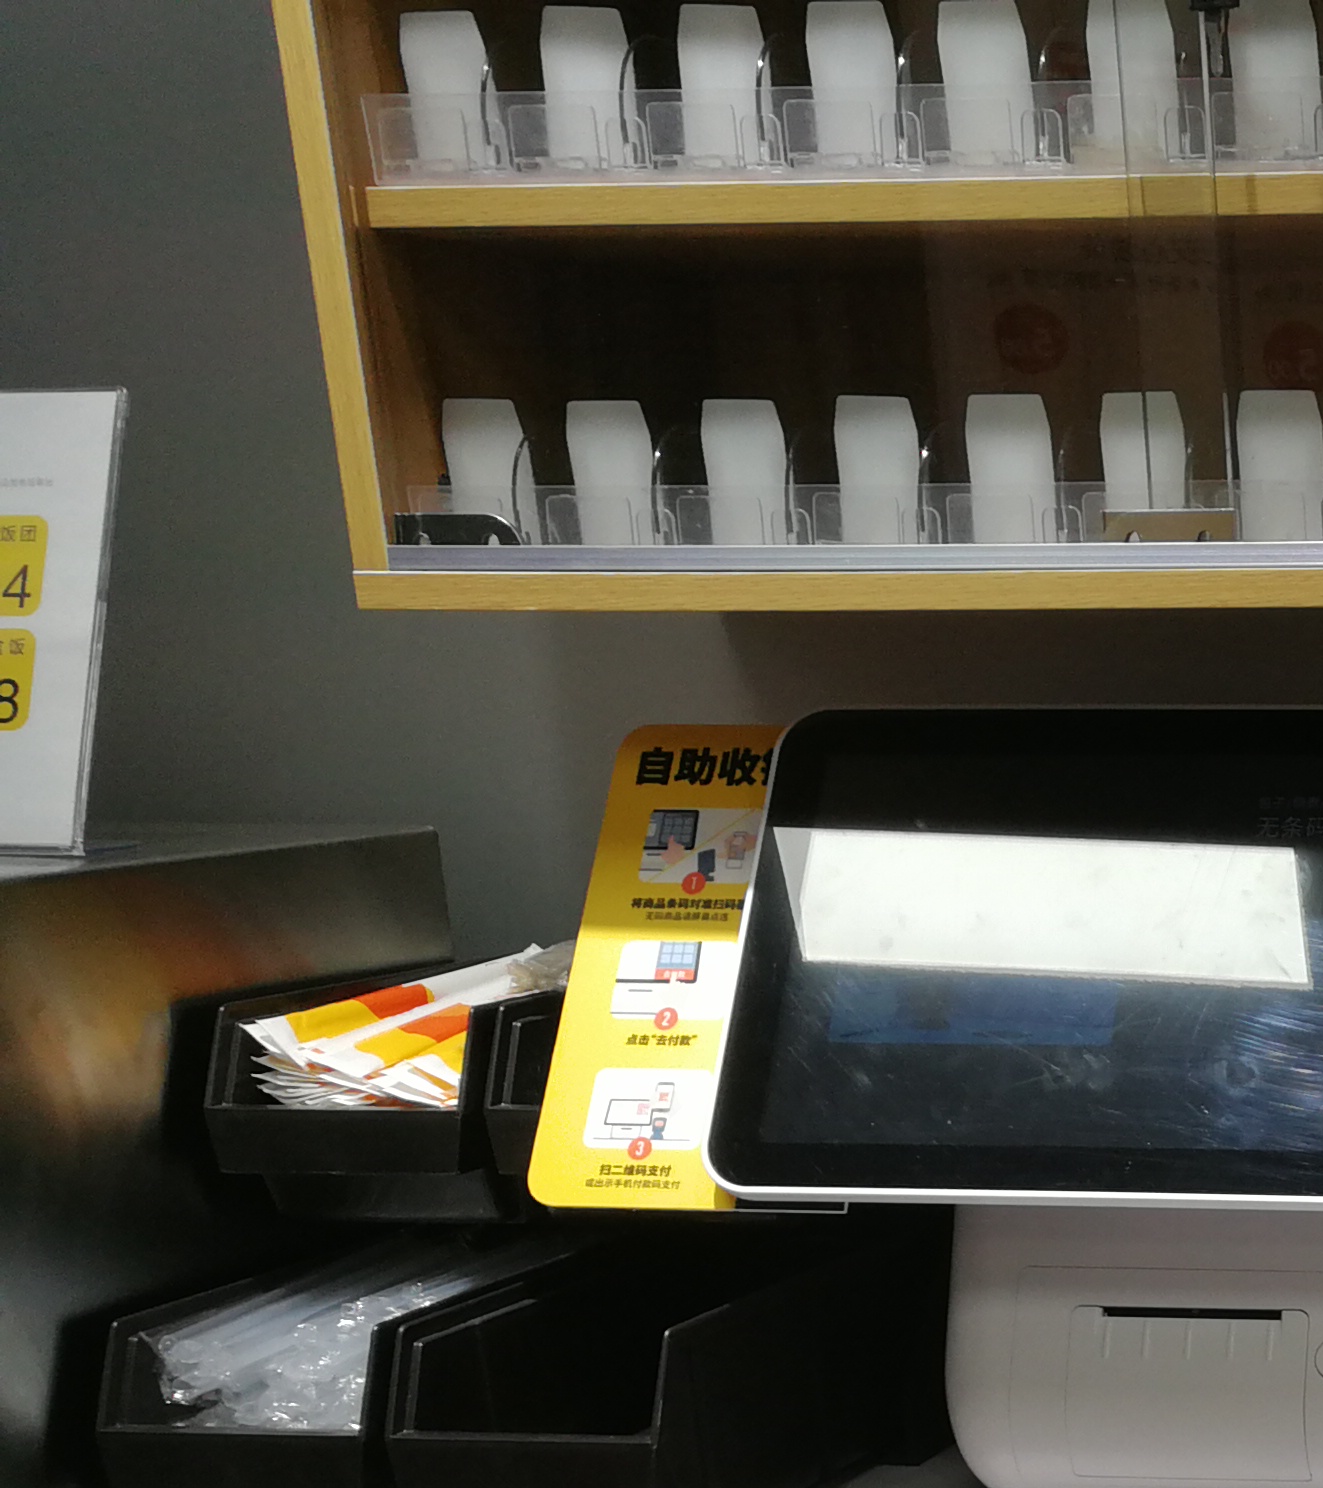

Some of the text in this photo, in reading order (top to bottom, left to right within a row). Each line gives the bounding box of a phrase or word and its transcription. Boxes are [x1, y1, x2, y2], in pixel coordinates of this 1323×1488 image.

[635, 747, 775, 786] 自助收
[634, 1140, 646, 1157] 3
[599, 1163, 672, 1178] 扫二维码支付
